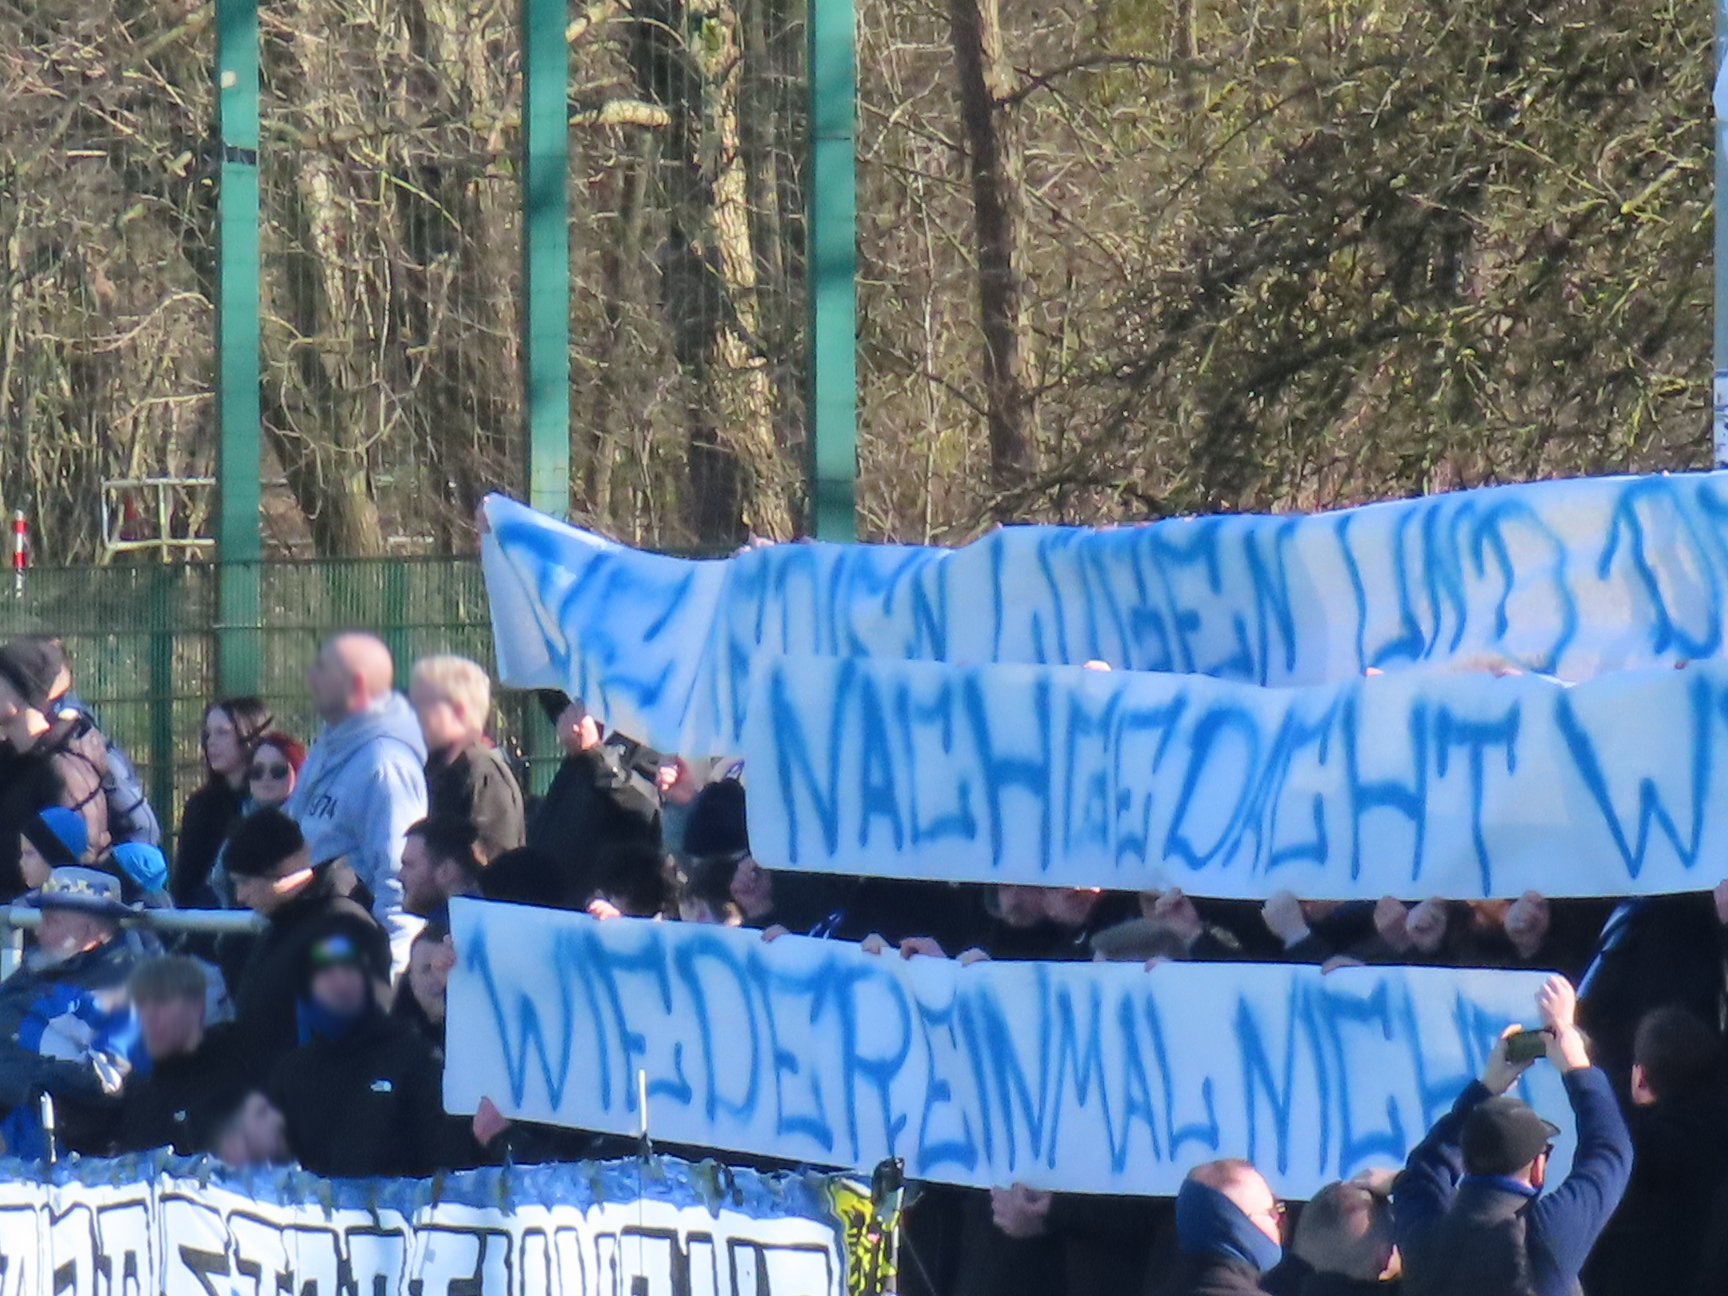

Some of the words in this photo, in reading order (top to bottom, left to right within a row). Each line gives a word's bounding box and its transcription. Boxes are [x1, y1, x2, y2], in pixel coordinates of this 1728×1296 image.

[768, 659, 1524, 896] NACHGEDACHT
[468, 926, 910, 1162] WIEDER
[912, 954, 1224, 1179] EINMAL
